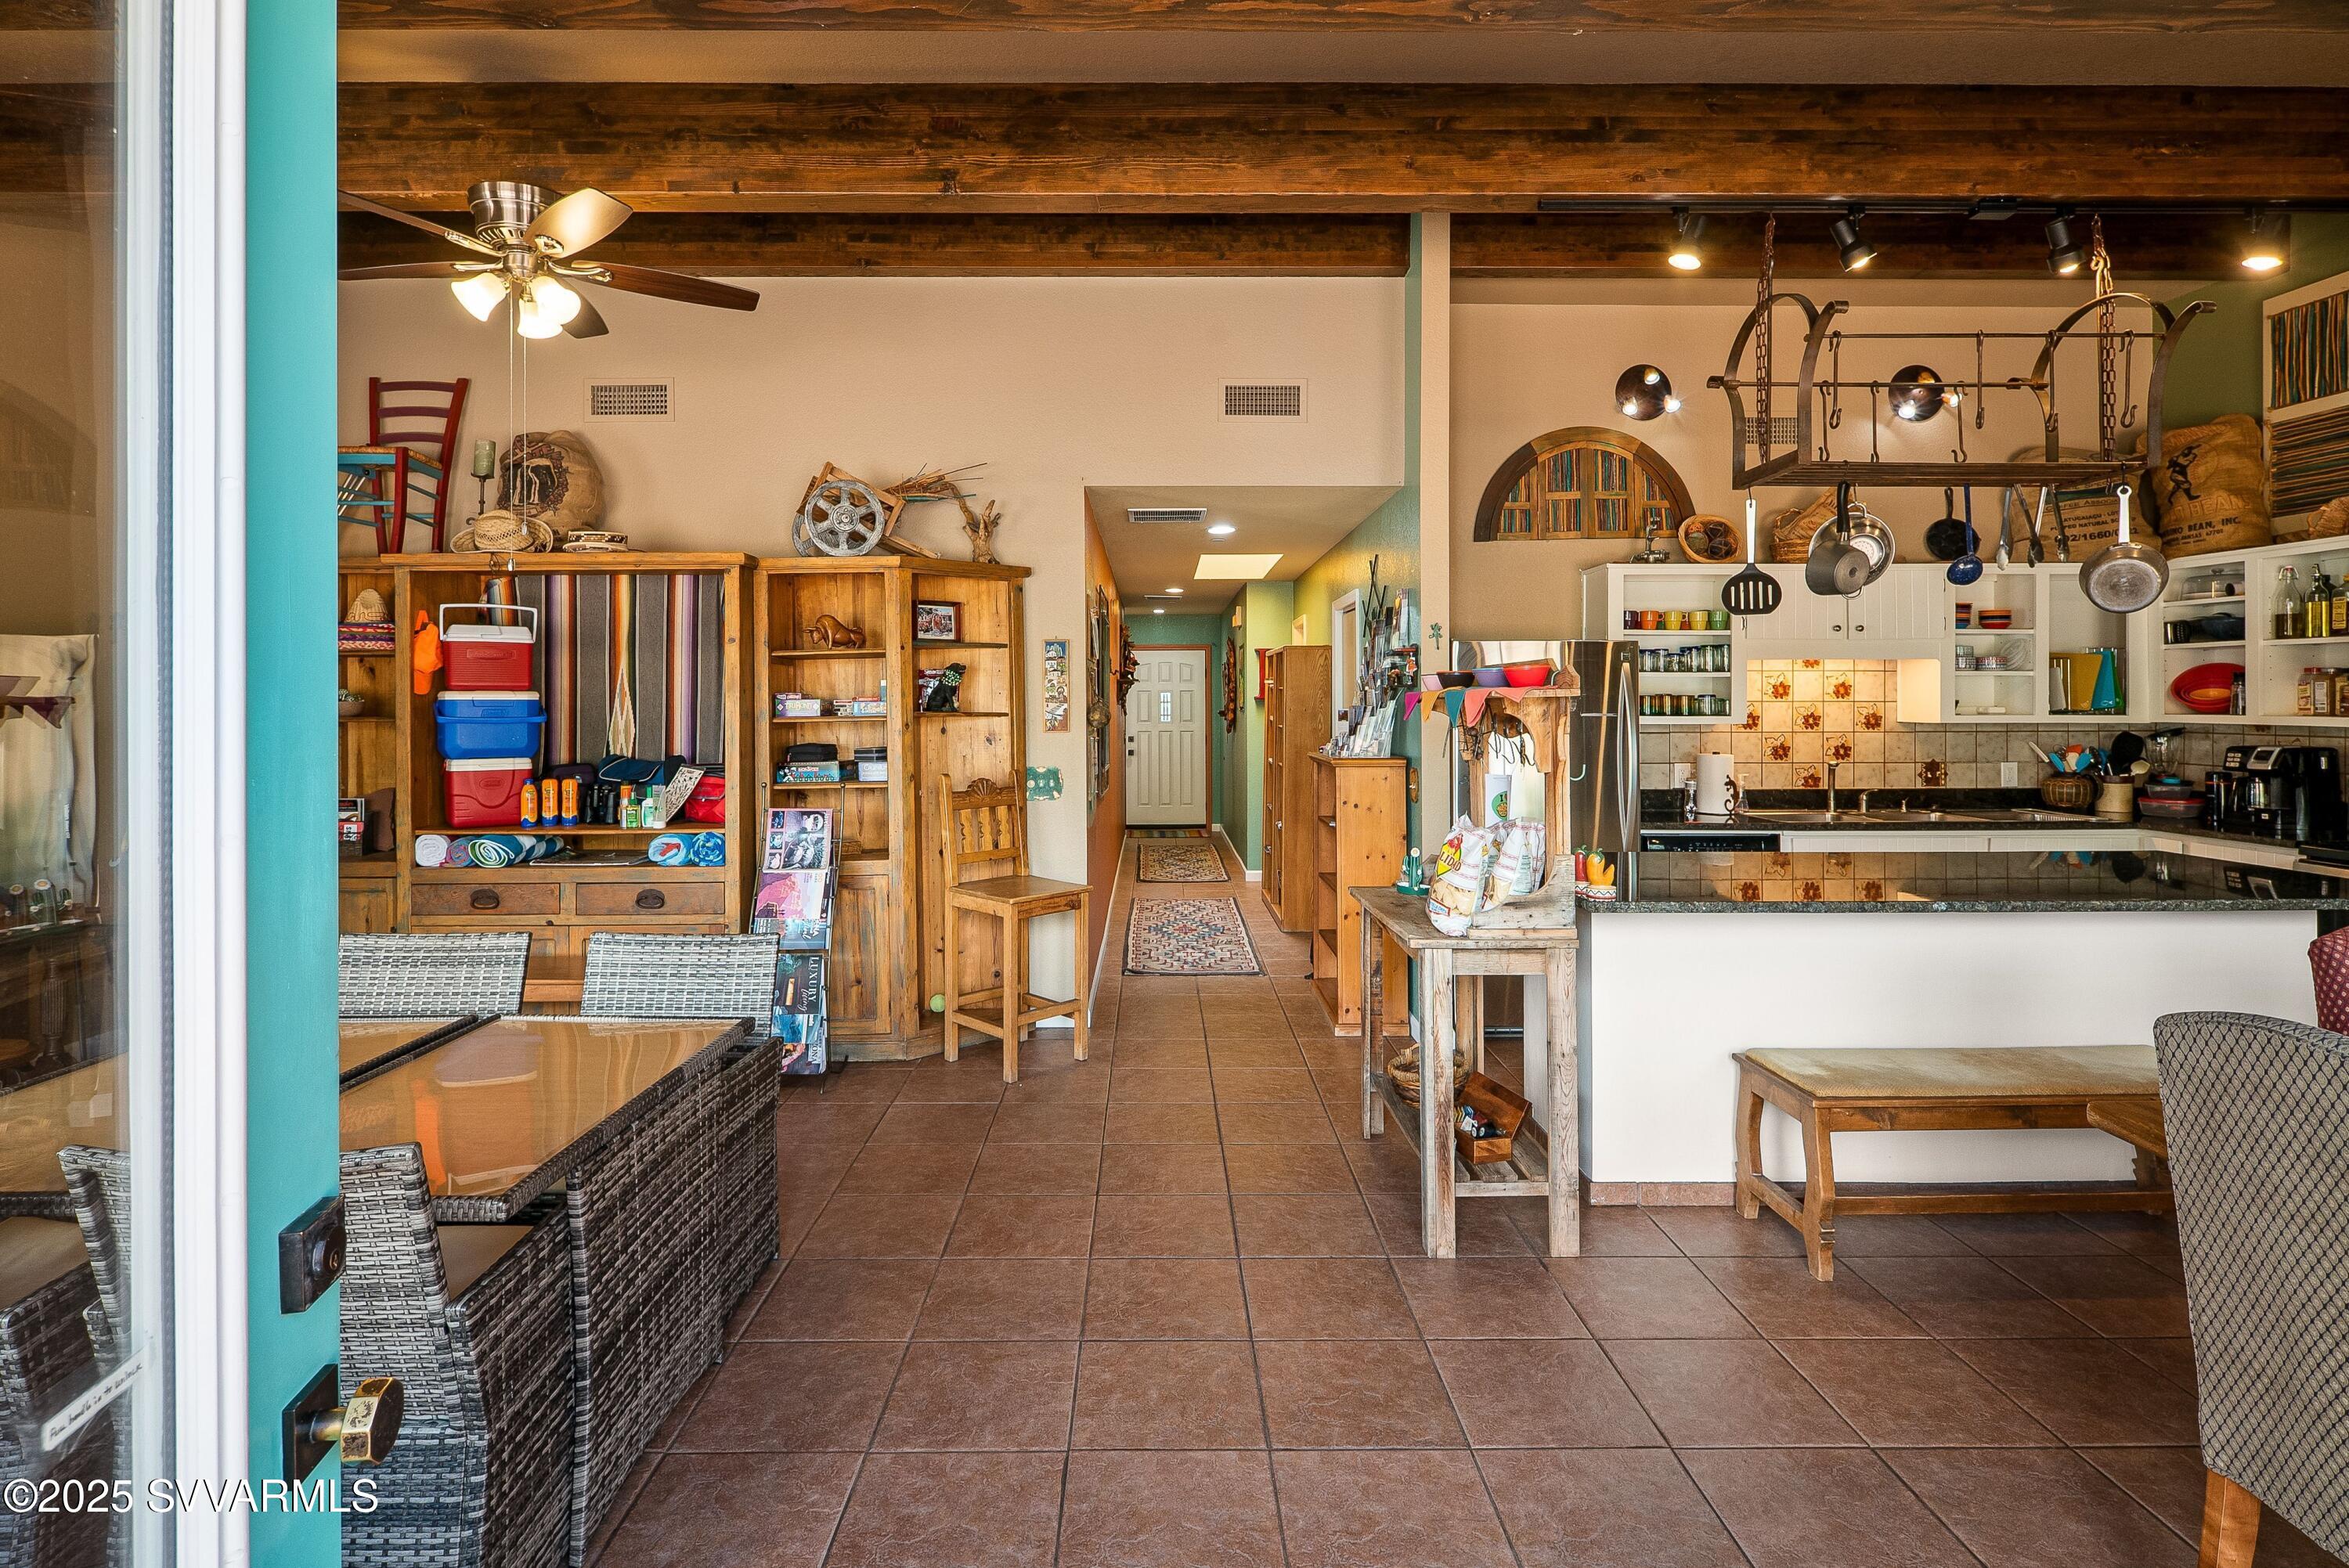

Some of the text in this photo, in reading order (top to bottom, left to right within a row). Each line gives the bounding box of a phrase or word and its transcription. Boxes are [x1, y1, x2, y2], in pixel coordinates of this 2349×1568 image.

[2050, 522, 2077, 532] PUPED
[2078, 519, 2109, 528] NATURAL
[2188, 520, 2217, 532] BEAN,
[2221, 516, 2242, 527] INC.
[808, 957, 820, 1002] LUXURY
